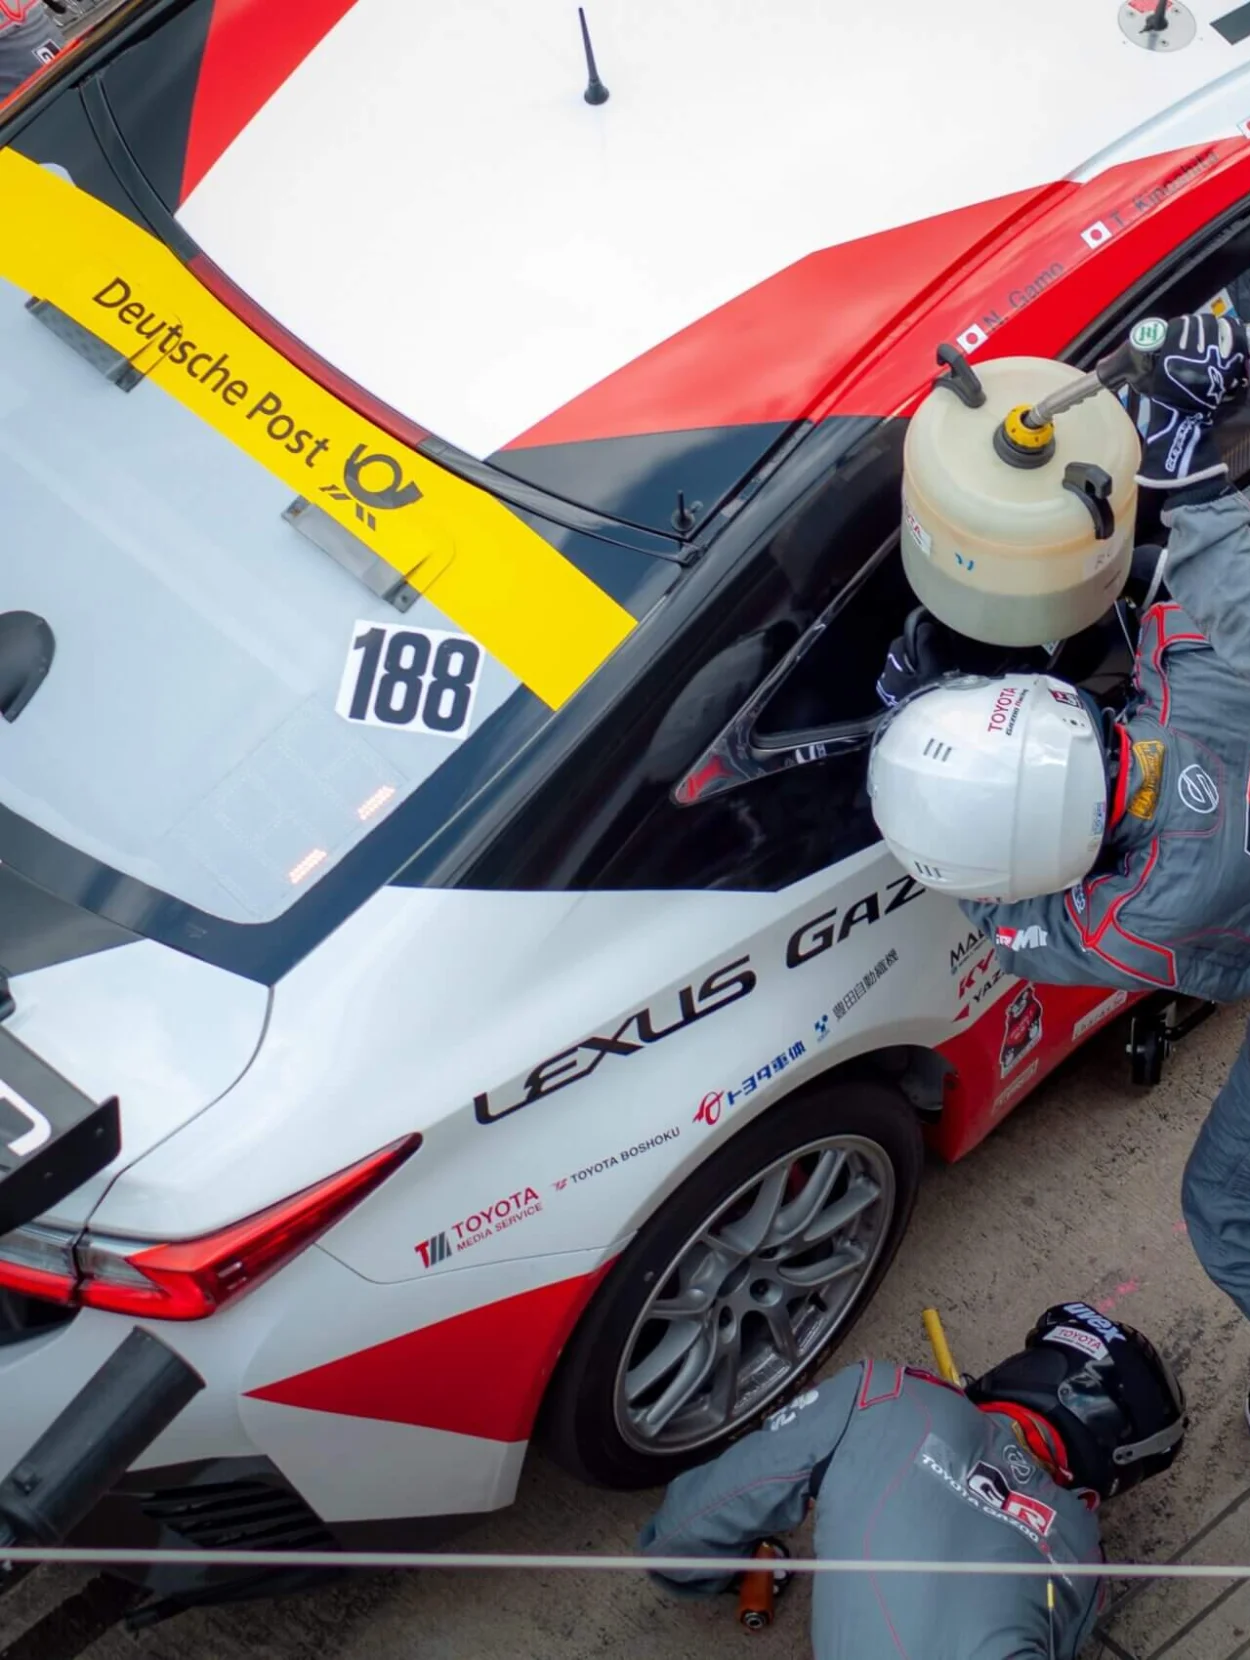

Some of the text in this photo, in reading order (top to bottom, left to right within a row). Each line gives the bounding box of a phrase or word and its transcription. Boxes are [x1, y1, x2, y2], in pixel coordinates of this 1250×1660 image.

[1008, 262, 1064, 309] Gamo
[92, 277, 330, 468] Deutsche Post
[348, 627, 481, 733] 188
[988, 687, 1018, 732] TOYOTA
[474, 873, 926, 1125] LEXUS GAZ
[570, 1127, 681, 1183] TOYOTA BOSHOKU
[451, 1187, 540, 1239] TOYOTA
[456, 1202, 543, 1252] MEDIA SERVICE
[1060, 1328, 1101, 1350] TOYOTA
[1063, 1303, 1127, 1343] uvex
[922, 1453, 1039, 1543] TOYOTA GAZOO
[968, 1474, 1047, 1535] GR
